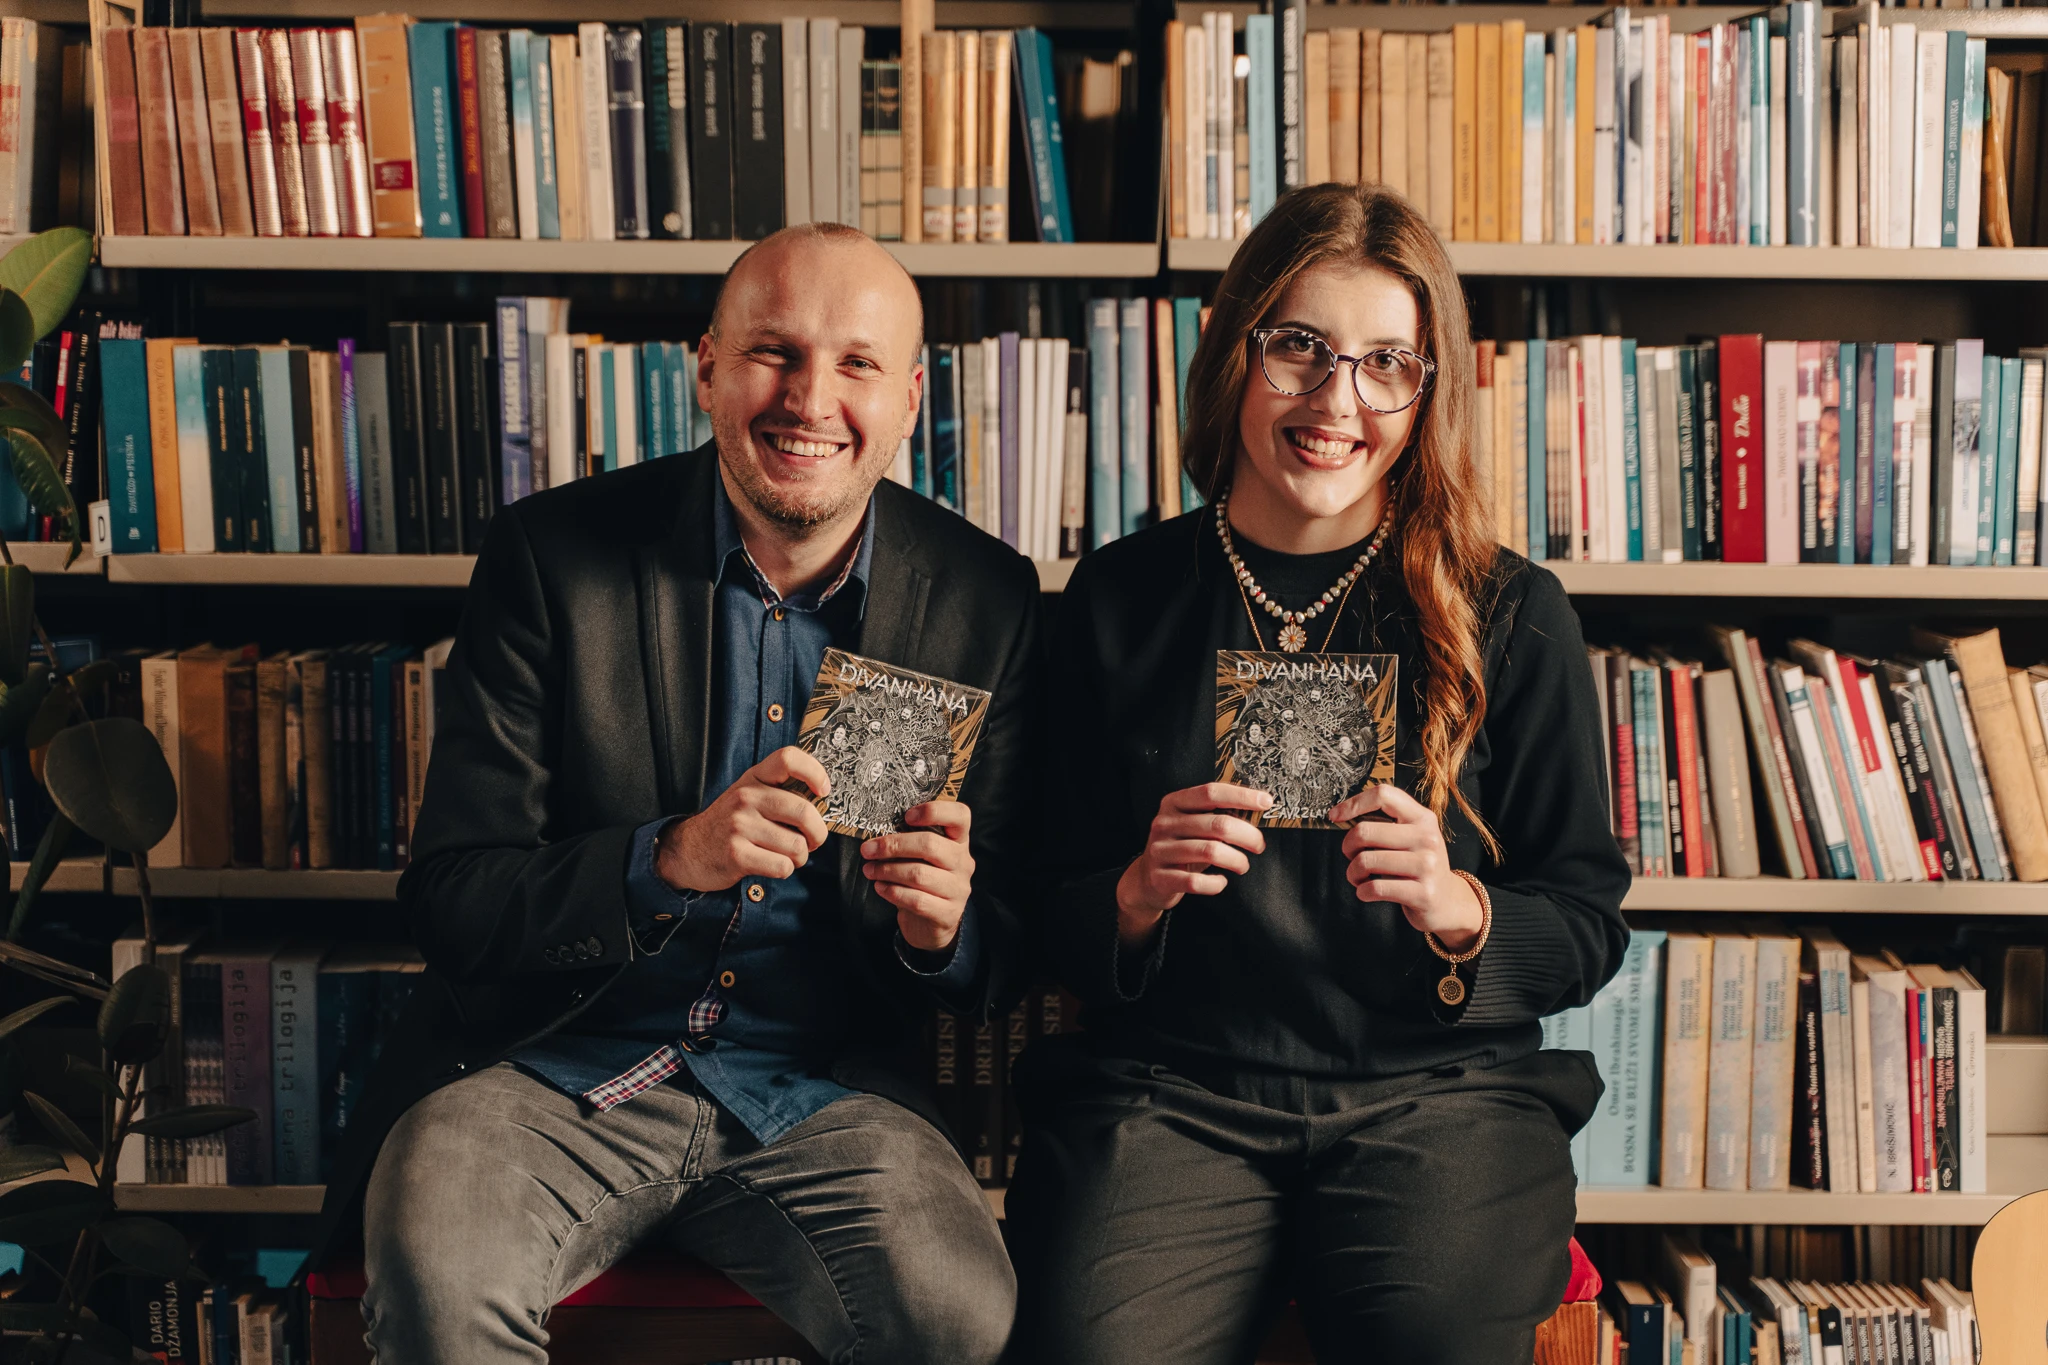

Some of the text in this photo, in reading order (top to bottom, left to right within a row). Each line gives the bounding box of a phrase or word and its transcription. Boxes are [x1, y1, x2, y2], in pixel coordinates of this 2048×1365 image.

[501, 307, 522, 433] BOSANSKI FENIKS
[836, 663, 969, 717] DIVANHANA
[1235, 660, 1378, 684] DIVANHANA
[1262, 805, 1331, 820] ZAVRZLAM
[228, 968, 249, 1175] ratn trilogija
[276, 968, 297, 1174] ratna trilogija
[937, 1010, 955, 1085] DREISE
[976, 1024, 992, 1085] DREIS
[1608, 994, 1624, 1116] Omer Ibrahimagić
[1624, 939, 1643, 1173] BOSNA SE BLIŽI SVOME SMIRAJU
[150, 1300, 164, 1344] DARIO
[164, 1279, 181, 1358] DŽAMONJA
